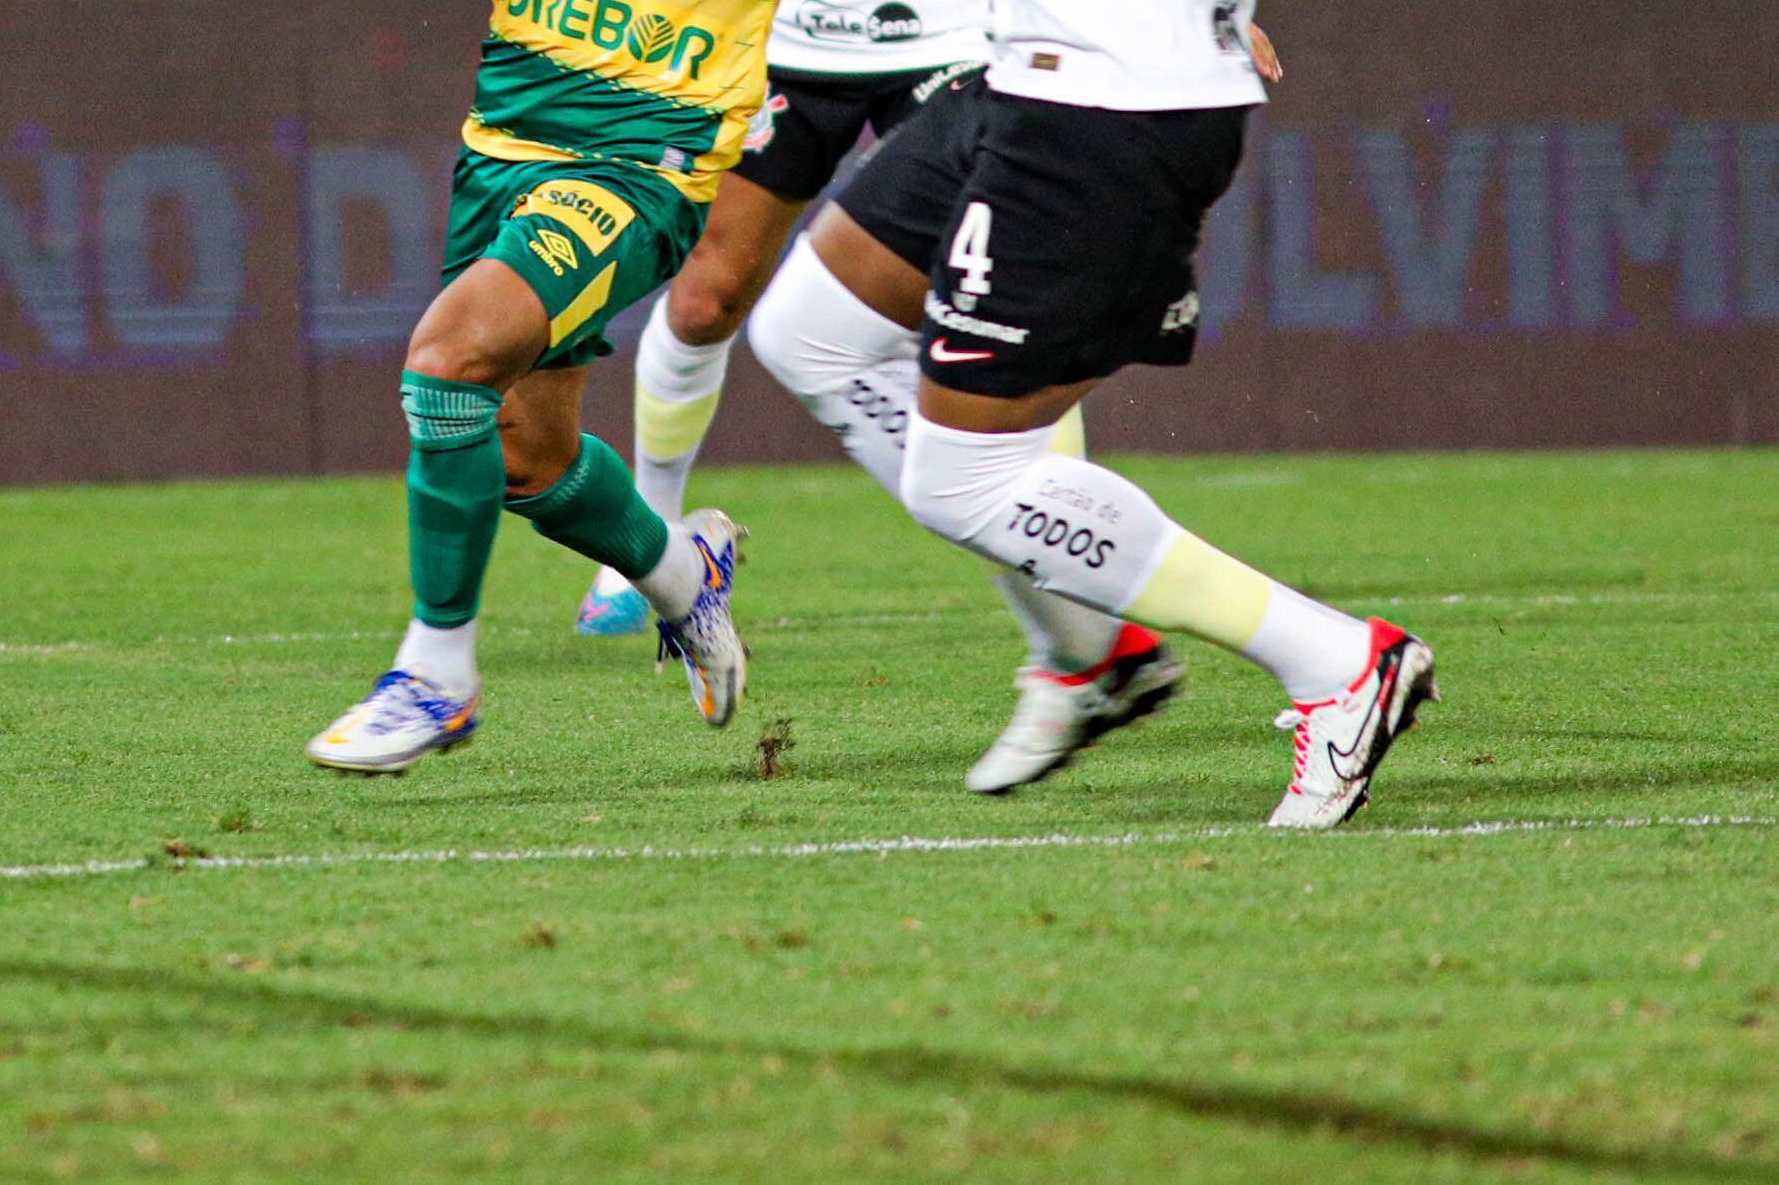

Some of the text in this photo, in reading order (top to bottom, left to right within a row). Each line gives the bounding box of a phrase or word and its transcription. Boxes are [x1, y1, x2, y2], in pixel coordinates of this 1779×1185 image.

[810, 13, 921, 38] Tele Sena
[529, 240, 564, 276] umbro
[949, 201, 994, 296] 4
[1007, 502, 1115, 568] TODOS
